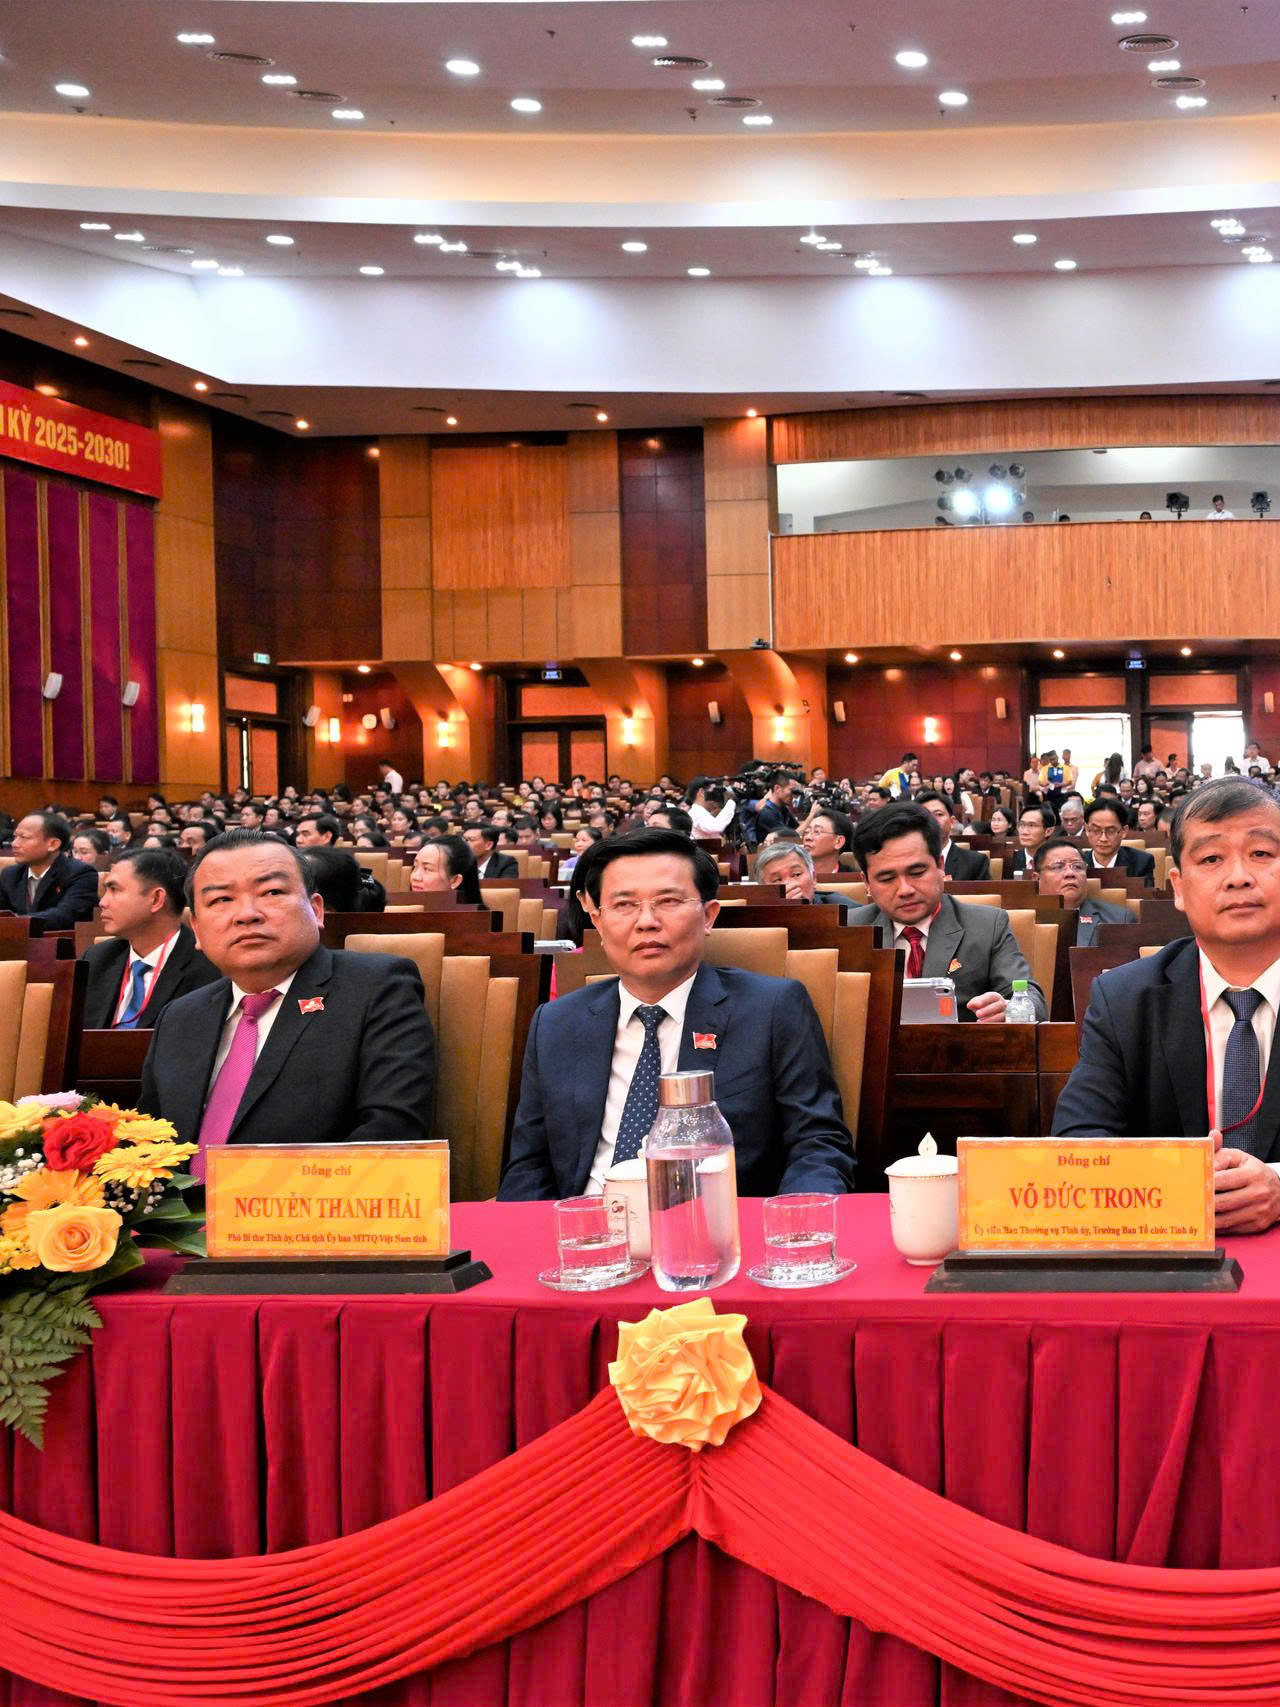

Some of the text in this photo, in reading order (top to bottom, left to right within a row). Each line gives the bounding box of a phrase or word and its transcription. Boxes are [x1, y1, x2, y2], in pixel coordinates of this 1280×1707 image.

[8, 404, 31, 442] KỲ
[34, 415, 130, 471] 2025-2030!
[334, 1165, 352, 1176] chí
[1057, 1153, 1110, 1168] Đồng chí
[315, 1198, 383, 1218] THANH
[387, 1192, 422, 1219] HẢI
[1008, 1181, 1163, 1209] VÕ ĐỨC TRONG
